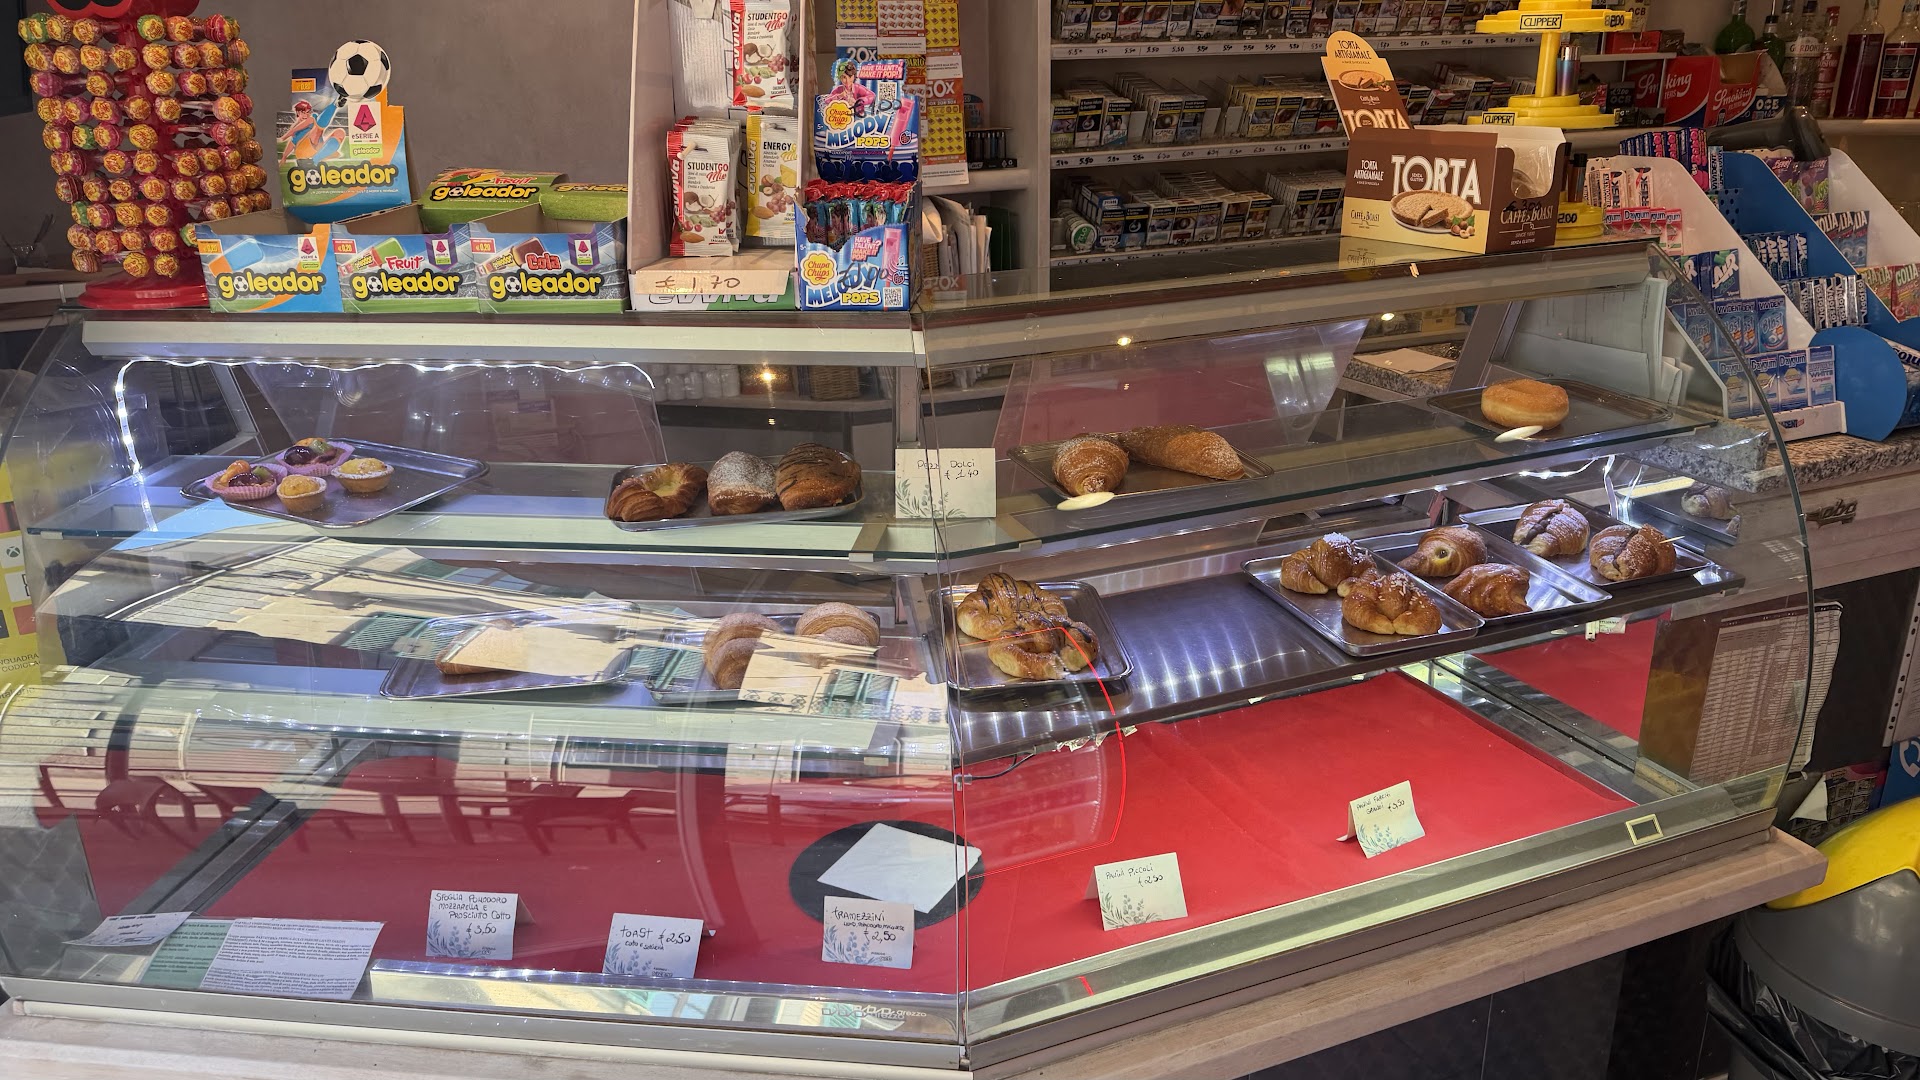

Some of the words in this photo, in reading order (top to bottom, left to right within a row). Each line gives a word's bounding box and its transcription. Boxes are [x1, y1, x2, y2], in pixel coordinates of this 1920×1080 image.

[747, 12, 788, 21] STUDENTGO
[1523, 16, 1561, 27] CLIPPER
[1338, 40, 1360, 50] TORTA
[1334, 50, 1372, 60] ARTIGIANALE
[1756, 99, 1779, 110] OCB
[1342, 109, 1410, 134] TORTA
[1484, 114, 1514, 124] CLIPPER
[827, 113, 891, 147] MELODY
[857, 137, 889, 147] POPS
[687, 162, 729, 172] STUDENTGO
[748, 140, 758, 196] evviva
[1362, 160, 1378, 170] TORTA
[290, 163, 396, 192] goleador
[1353, 169, 1384, 181] ARTIGIANALE
[1391, 155, 1482, 205] TORTA
[433, 184, 537, 200] goleador
[1624, 211, 1650, 222] Daygum
[480, 244, 491, 252] 0,20
[854, 240, 882, 250] TALENT?
[527, 253, 562, 270] Cola
[808, 261, 830, 270] Chupa
[808, 269, 830, 277] Chups
[1712, 254, 1738, 289] AIR
[1895, 264, 1919, 287] GOLIA
[218, 271, 323, 299] goleador
[352, 272, 460, 299] goleador
[489, 272, 601, 299] goleador
[692, 275, 741, 293] 1,70
[807, 265, 879, 305] MELODY
[842, 292, 879, 304] POPS
[1751, 360, 1777, 371] Daygum
[1780, 354, 1805, 367] Daygum
[435, 893, 463, 902] SFOGLIA
[469, 894, 508, 904] POMODORO
[439, 903, 479, 911] MOZZARELLA
[449, 911, 488, 920] PROSCIUTTO
[466, 922, 472, 939] €
[666, 932, 691, 945] 2,50
[872, 931, 896, 944] 2,50
[896, 1009, 927, 1017] arezzo
